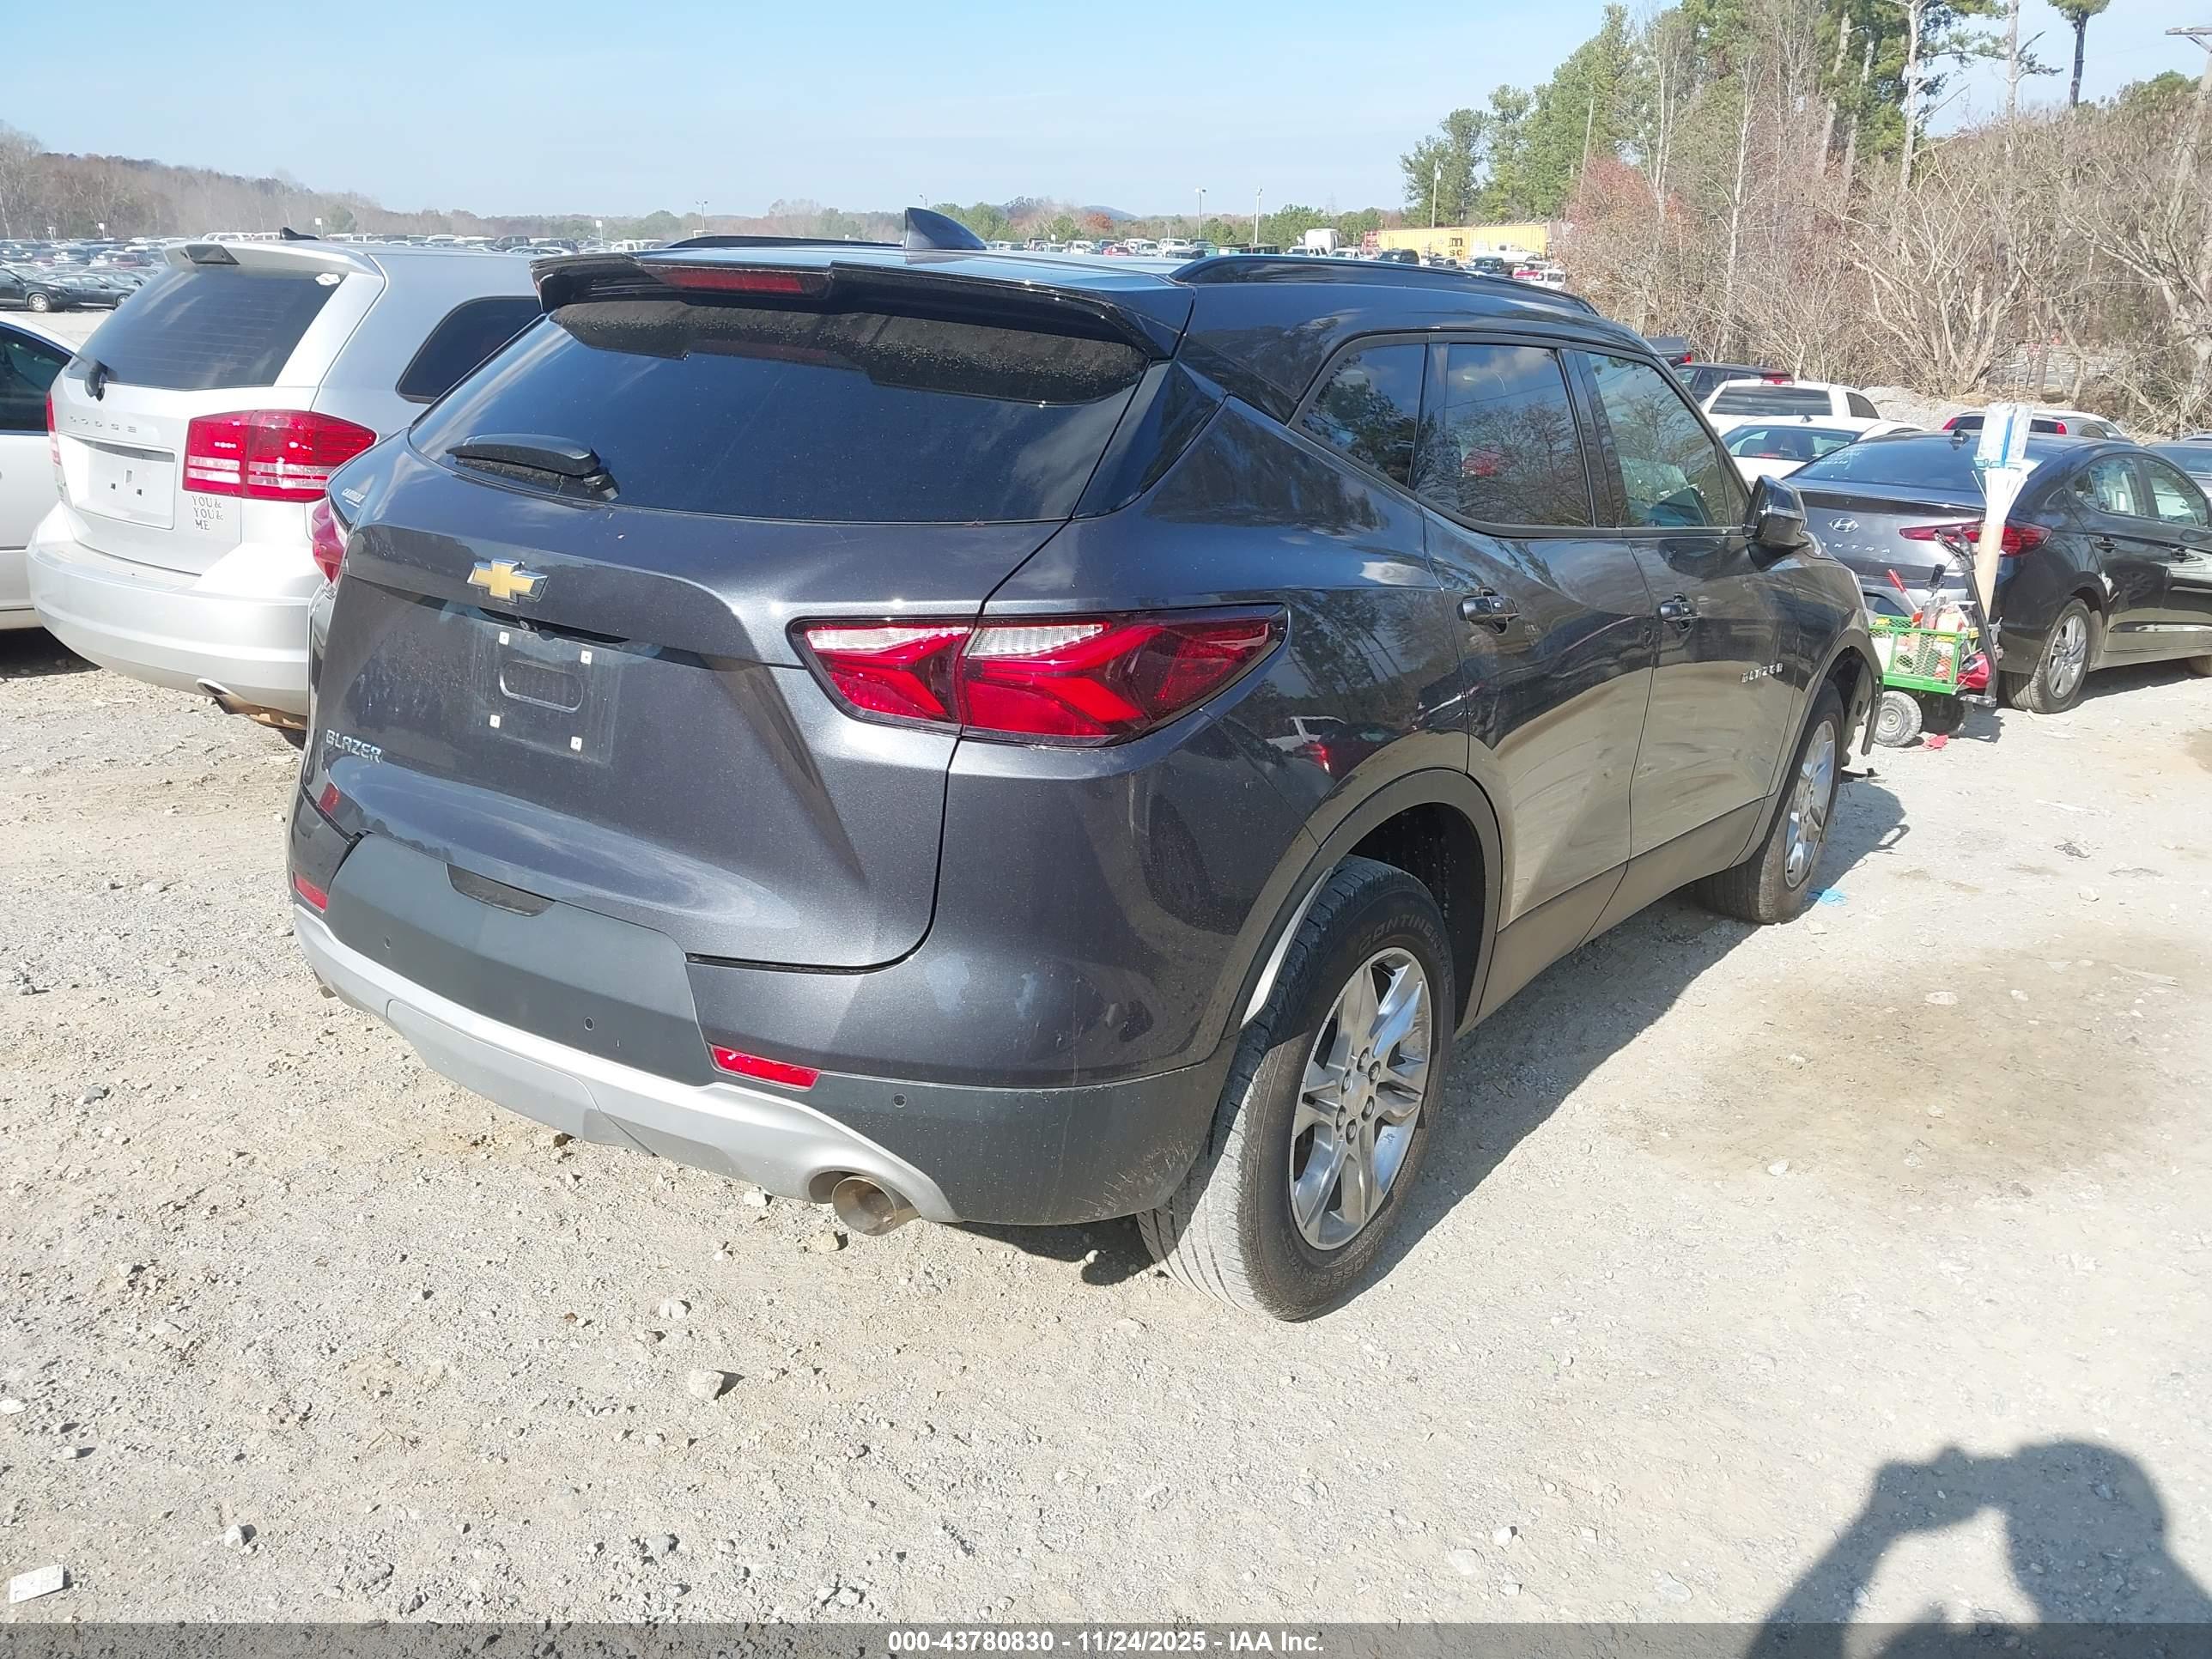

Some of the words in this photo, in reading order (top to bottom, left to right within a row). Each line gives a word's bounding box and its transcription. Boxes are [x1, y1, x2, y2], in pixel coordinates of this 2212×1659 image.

[194, 519, 210, 531] ME
[1741, 662, 1784, 684] BLAZER
[325, 728, 383, 764] BLAZER
